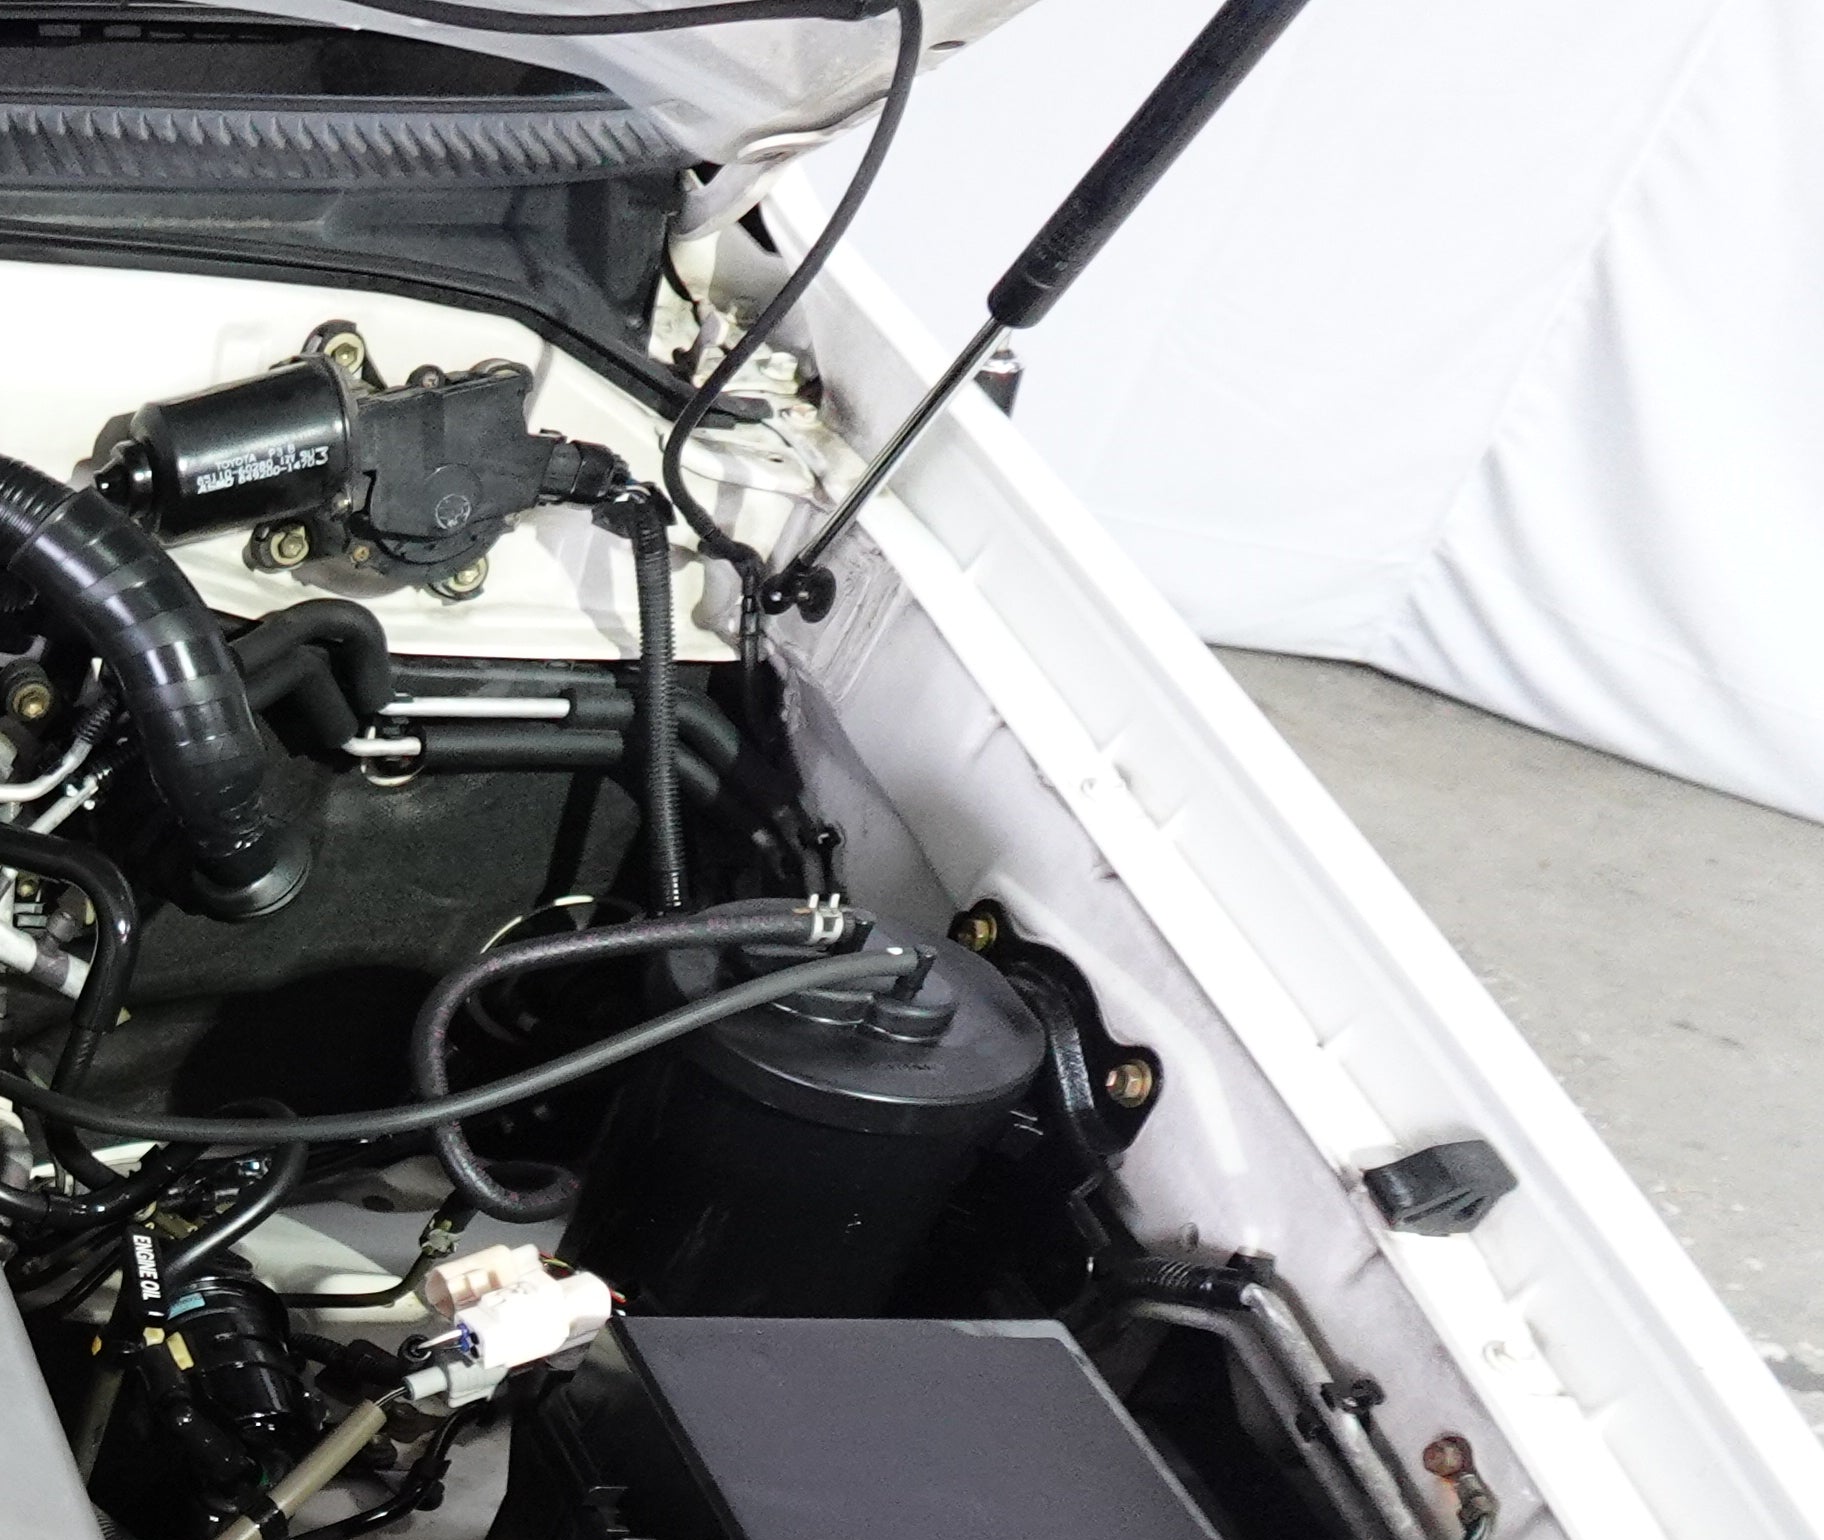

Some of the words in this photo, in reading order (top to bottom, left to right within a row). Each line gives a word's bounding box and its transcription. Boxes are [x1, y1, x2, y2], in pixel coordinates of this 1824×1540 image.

[216, 453, 257, 471] TOYOTA
[133, 1235, 158, 1279] ENGINE
[139, 1280, 162, 1302] OIL
